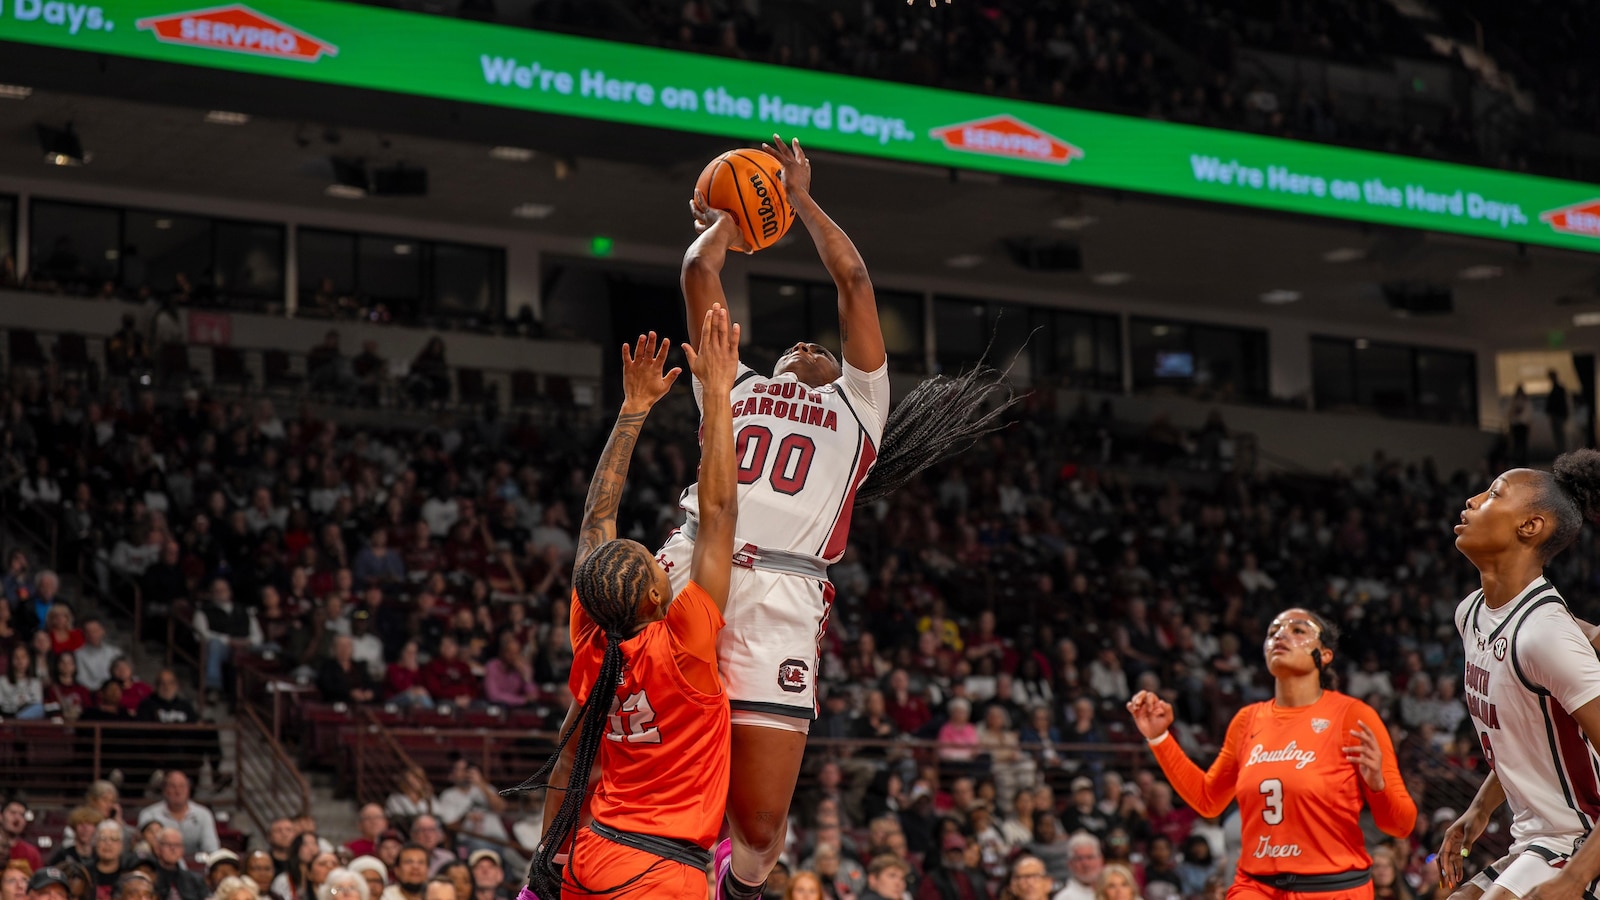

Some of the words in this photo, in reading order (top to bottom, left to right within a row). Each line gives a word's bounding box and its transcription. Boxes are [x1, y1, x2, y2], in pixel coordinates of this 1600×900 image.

[14, 0, 115, 35] Days.
[180, 17, 297, 51] SERVPRO
[480, 54, 574, 95] We're
[580, 68, 655, 106] Here
[661, 86, 699, 112] on
[703, 86, 754, 119] the
[758, 93, 833, 130] Hard
[837, 105, 915, 144] Days.
[750, 174, 778, 240] Wilson
[1190, 154, 1264, 189] We're
[1267, 165, 1327, 197] Here
[1330, 179, 1361, 201] on
[1363, 179, 1403, 208] the
[1405, 185, 1464, 216] Hard
[1466, 192, 1529, 228] Days.
[731, 396, 837, 432] CAROLINA
[753, 382, 822, 405] SOUTH
[735, 425, 816, 496] 00
[603, 689, 662, 744] 12
[1245, 740, 1316, 769] Bowling
[1259, 778, 1284, 826] 3
[1253, 835, 1302, 859] Green
